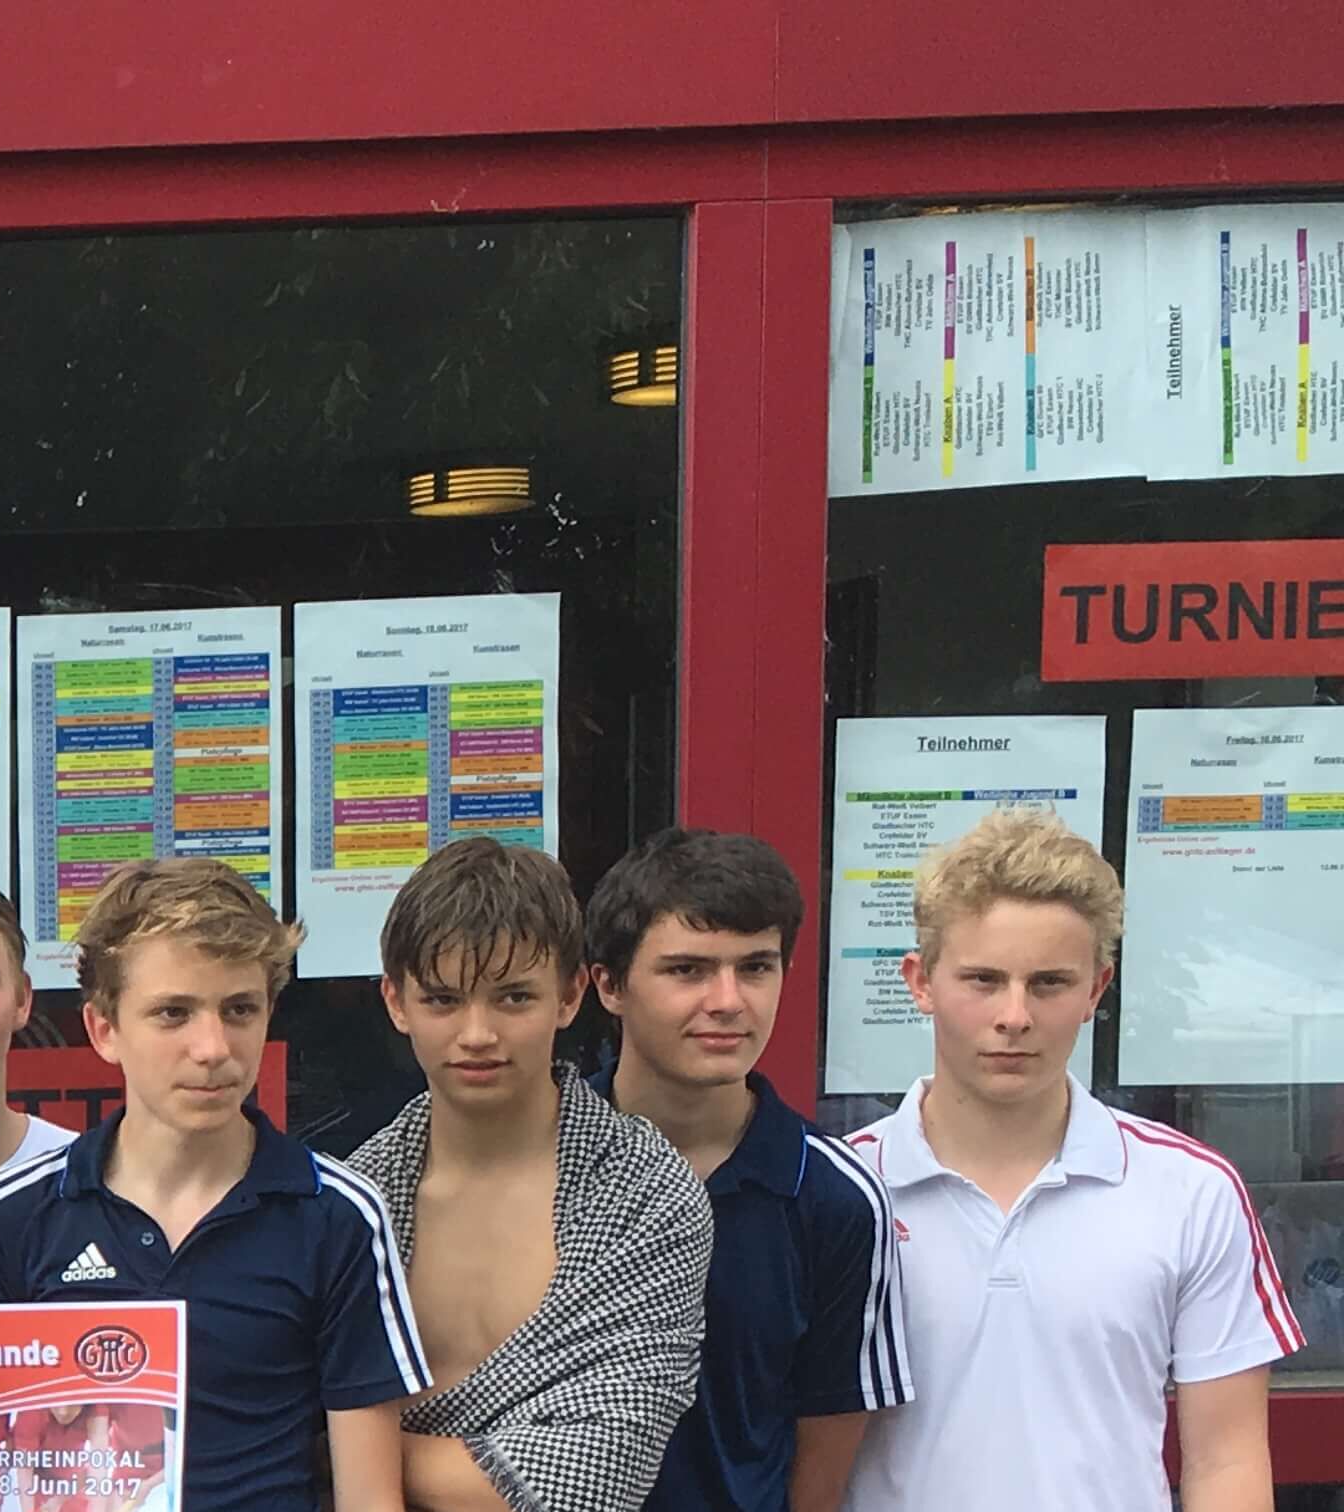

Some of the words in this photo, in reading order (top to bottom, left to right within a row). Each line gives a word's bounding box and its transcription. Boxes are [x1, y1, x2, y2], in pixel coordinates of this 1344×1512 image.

[1167, 305, 1183, 400] Teilnehmer
[917, 736, 1011, 751] Teilnehmer
[62, 1266, 116, 1282] adidas
[28, 1475, 77, 1495] Juni
[85, 1478, 141, 1497] 2017
